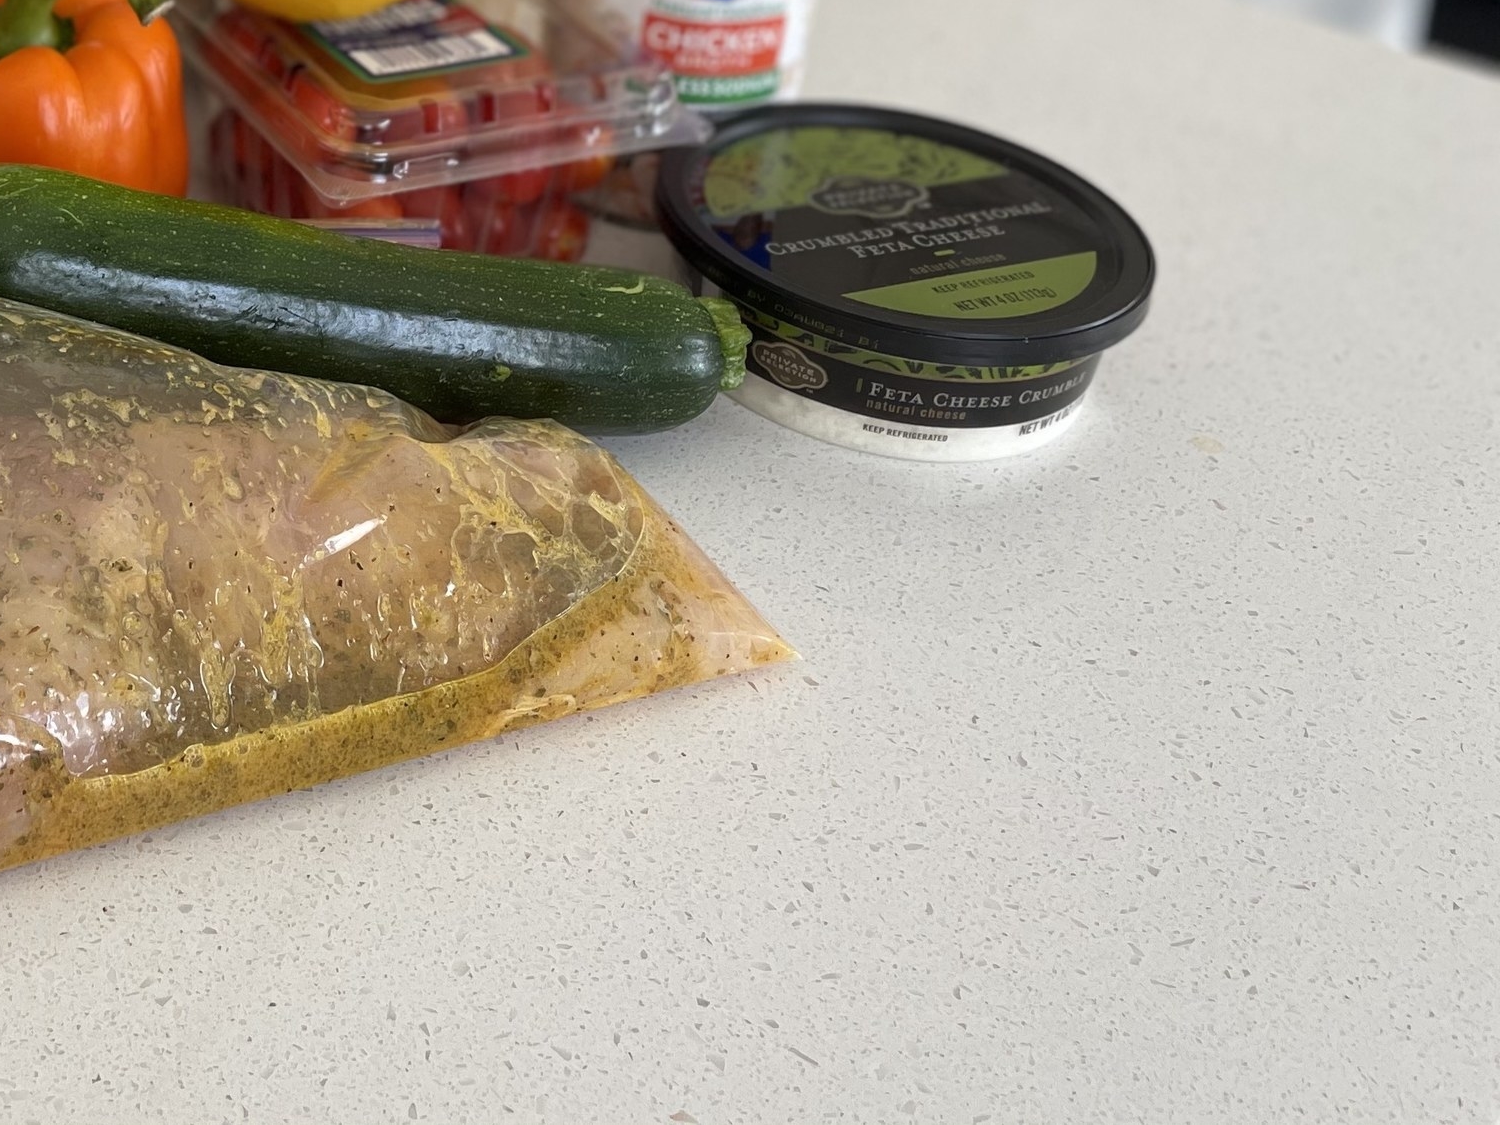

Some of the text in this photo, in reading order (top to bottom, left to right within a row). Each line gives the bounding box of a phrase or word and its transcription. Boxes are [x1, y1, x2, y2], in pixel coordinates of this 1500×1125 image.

[764, 226, 894, 257] CRUMBLED
[891, 200, 1052, 233] TRADITIONAL
[846, 225, 1006, 259] FETA CHEESE
[908, 252, 1007, 277] natural cheese
[931, 269, 1036, 295] KEEP REFRIGERATED
[952, 300, 979, 313] NET
[976, 296, 998, 309] WT
[995, 292, 1008, 306] 4
[1007, 290, 1024, 305] OZ
[759, 355, 818, 384] SELECTION
[762, 348, 816, 376] PRIVATE
[868, 381, 925, 406] FETA
[933, 392, 1013, 409] CHEESE
[866, 398, 968, 421] natural cheese
[862, 423, 950, 443] KEEP REFRIGERATED
[1018, 421, 1041, 437] NET
